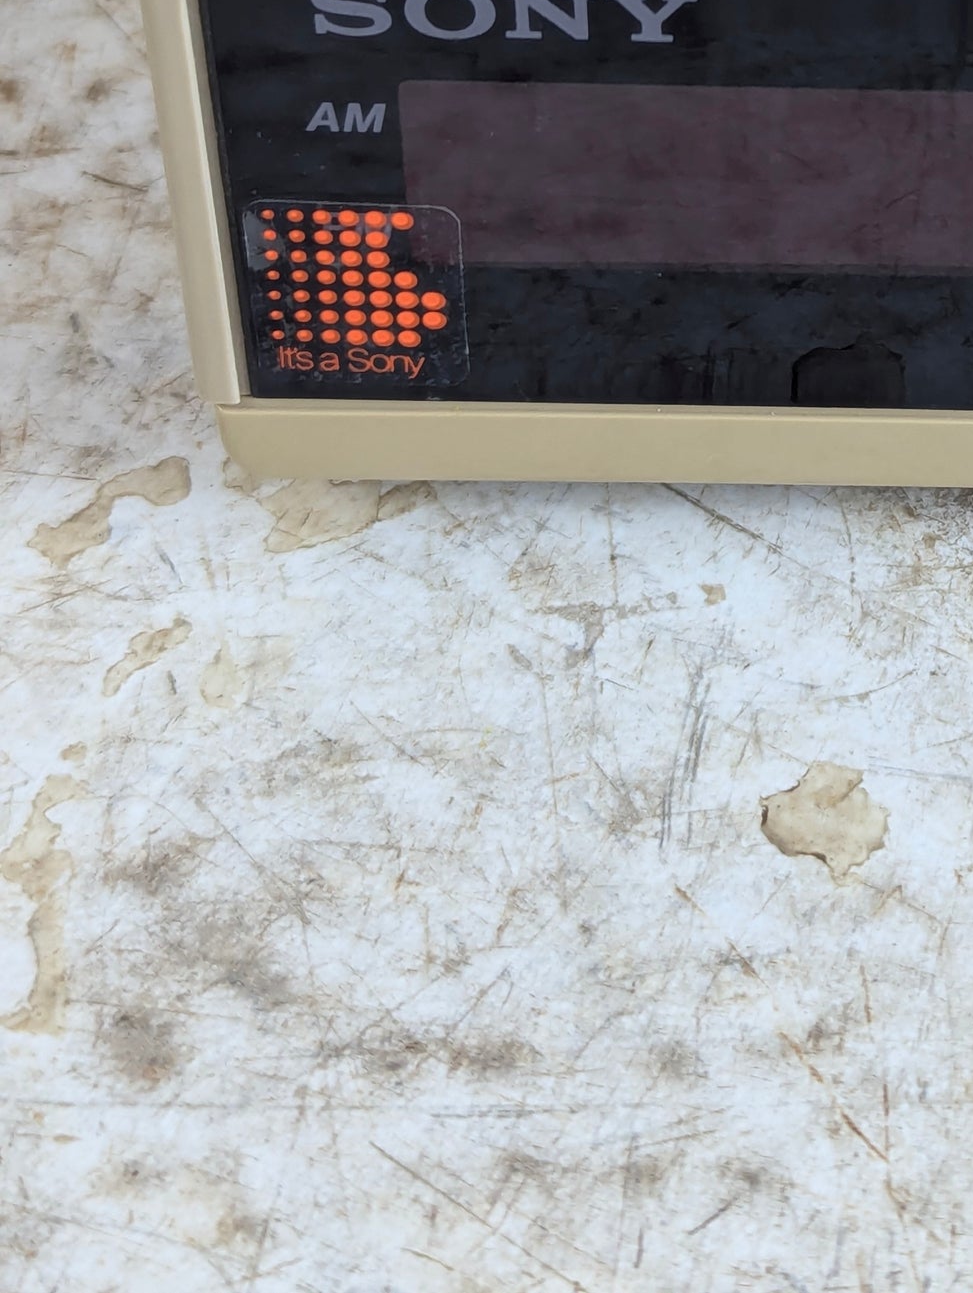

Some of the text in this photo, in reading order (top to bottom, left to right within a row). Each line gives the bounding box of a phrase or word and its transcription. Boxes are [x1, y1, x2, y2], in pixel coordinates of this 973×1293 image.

[306, 102, 386, 133] AM
[278, 345, 426, 379] It's a Sony
